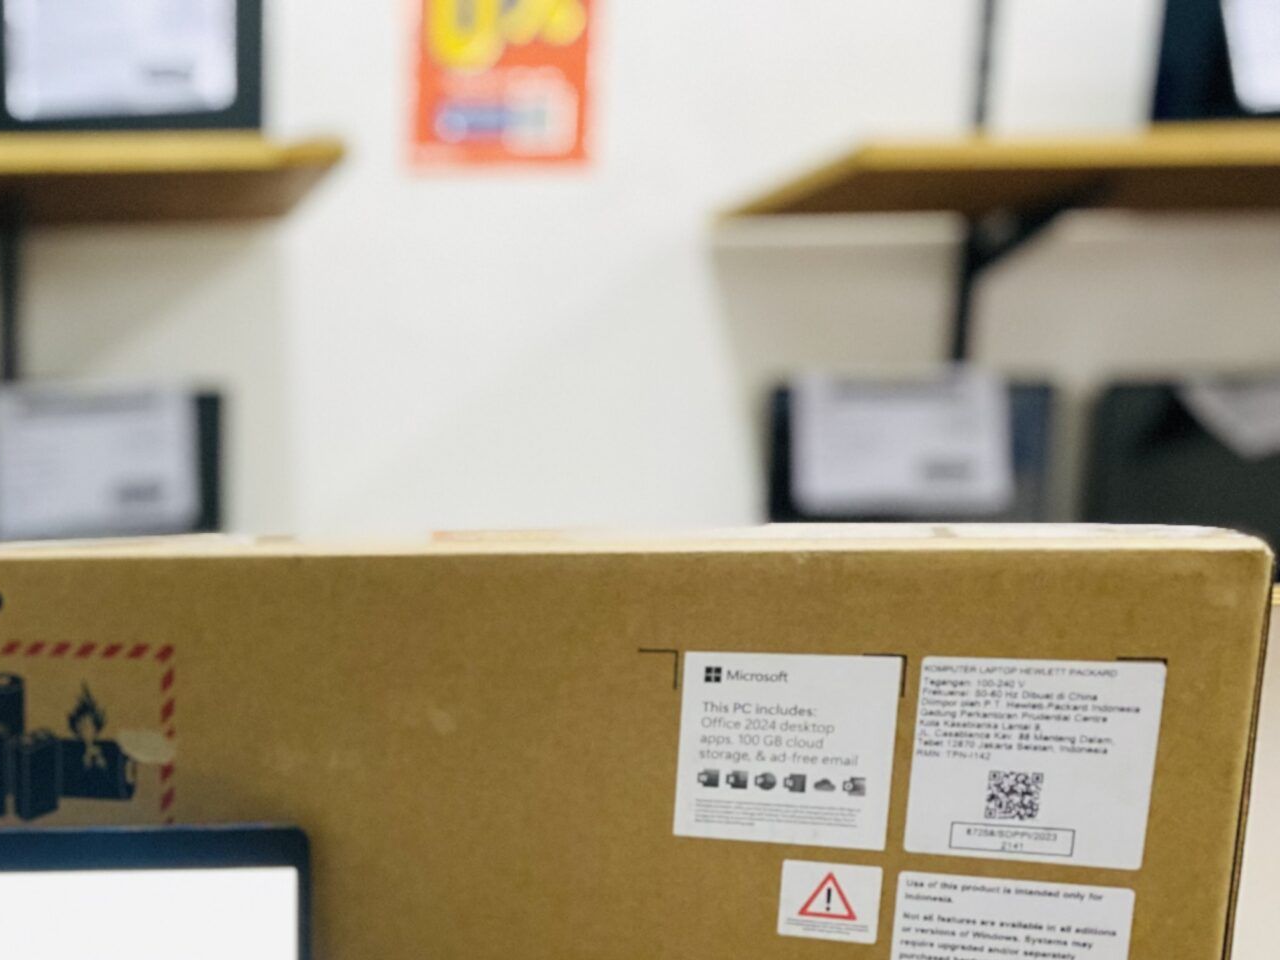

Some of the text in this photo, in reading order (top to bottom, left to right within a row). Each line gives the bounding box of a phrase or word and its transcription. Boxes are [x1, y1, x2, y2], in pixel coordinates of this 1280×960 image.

[726, 669, 788, 682] Microsoft
[1067, 693, 1098, 701] China
[702, 701, 817, 716] This PC includes:
[700, 717, 835, 735] Office 2024 desktop
[738, 733, 760, 745] 100
[762, 734, 783, 746] GB
[785, 735, 823, 748] cloud
[755, 750, 765, 761] &
[821, 754, 858, 766] email
[906, 879, 924, 887] Use
[939, 882, 957, 890] this
[961, 883, 1000, 895] product
[1014, 888, 1059, 898] intended
[1062, 892, 1085, 902] only
[1088, 894, 1103, 902] for
[936, 914, 977, 925] features
[1045, 924, 1056, 932] in
[900, 938, 934, 949] require
[937, 941, 984, 954] upgraded
[914, 926, 956, 936] versions
[1023, 936, 1068, 948] Systems
[1071, 942, 1092, 951] may
